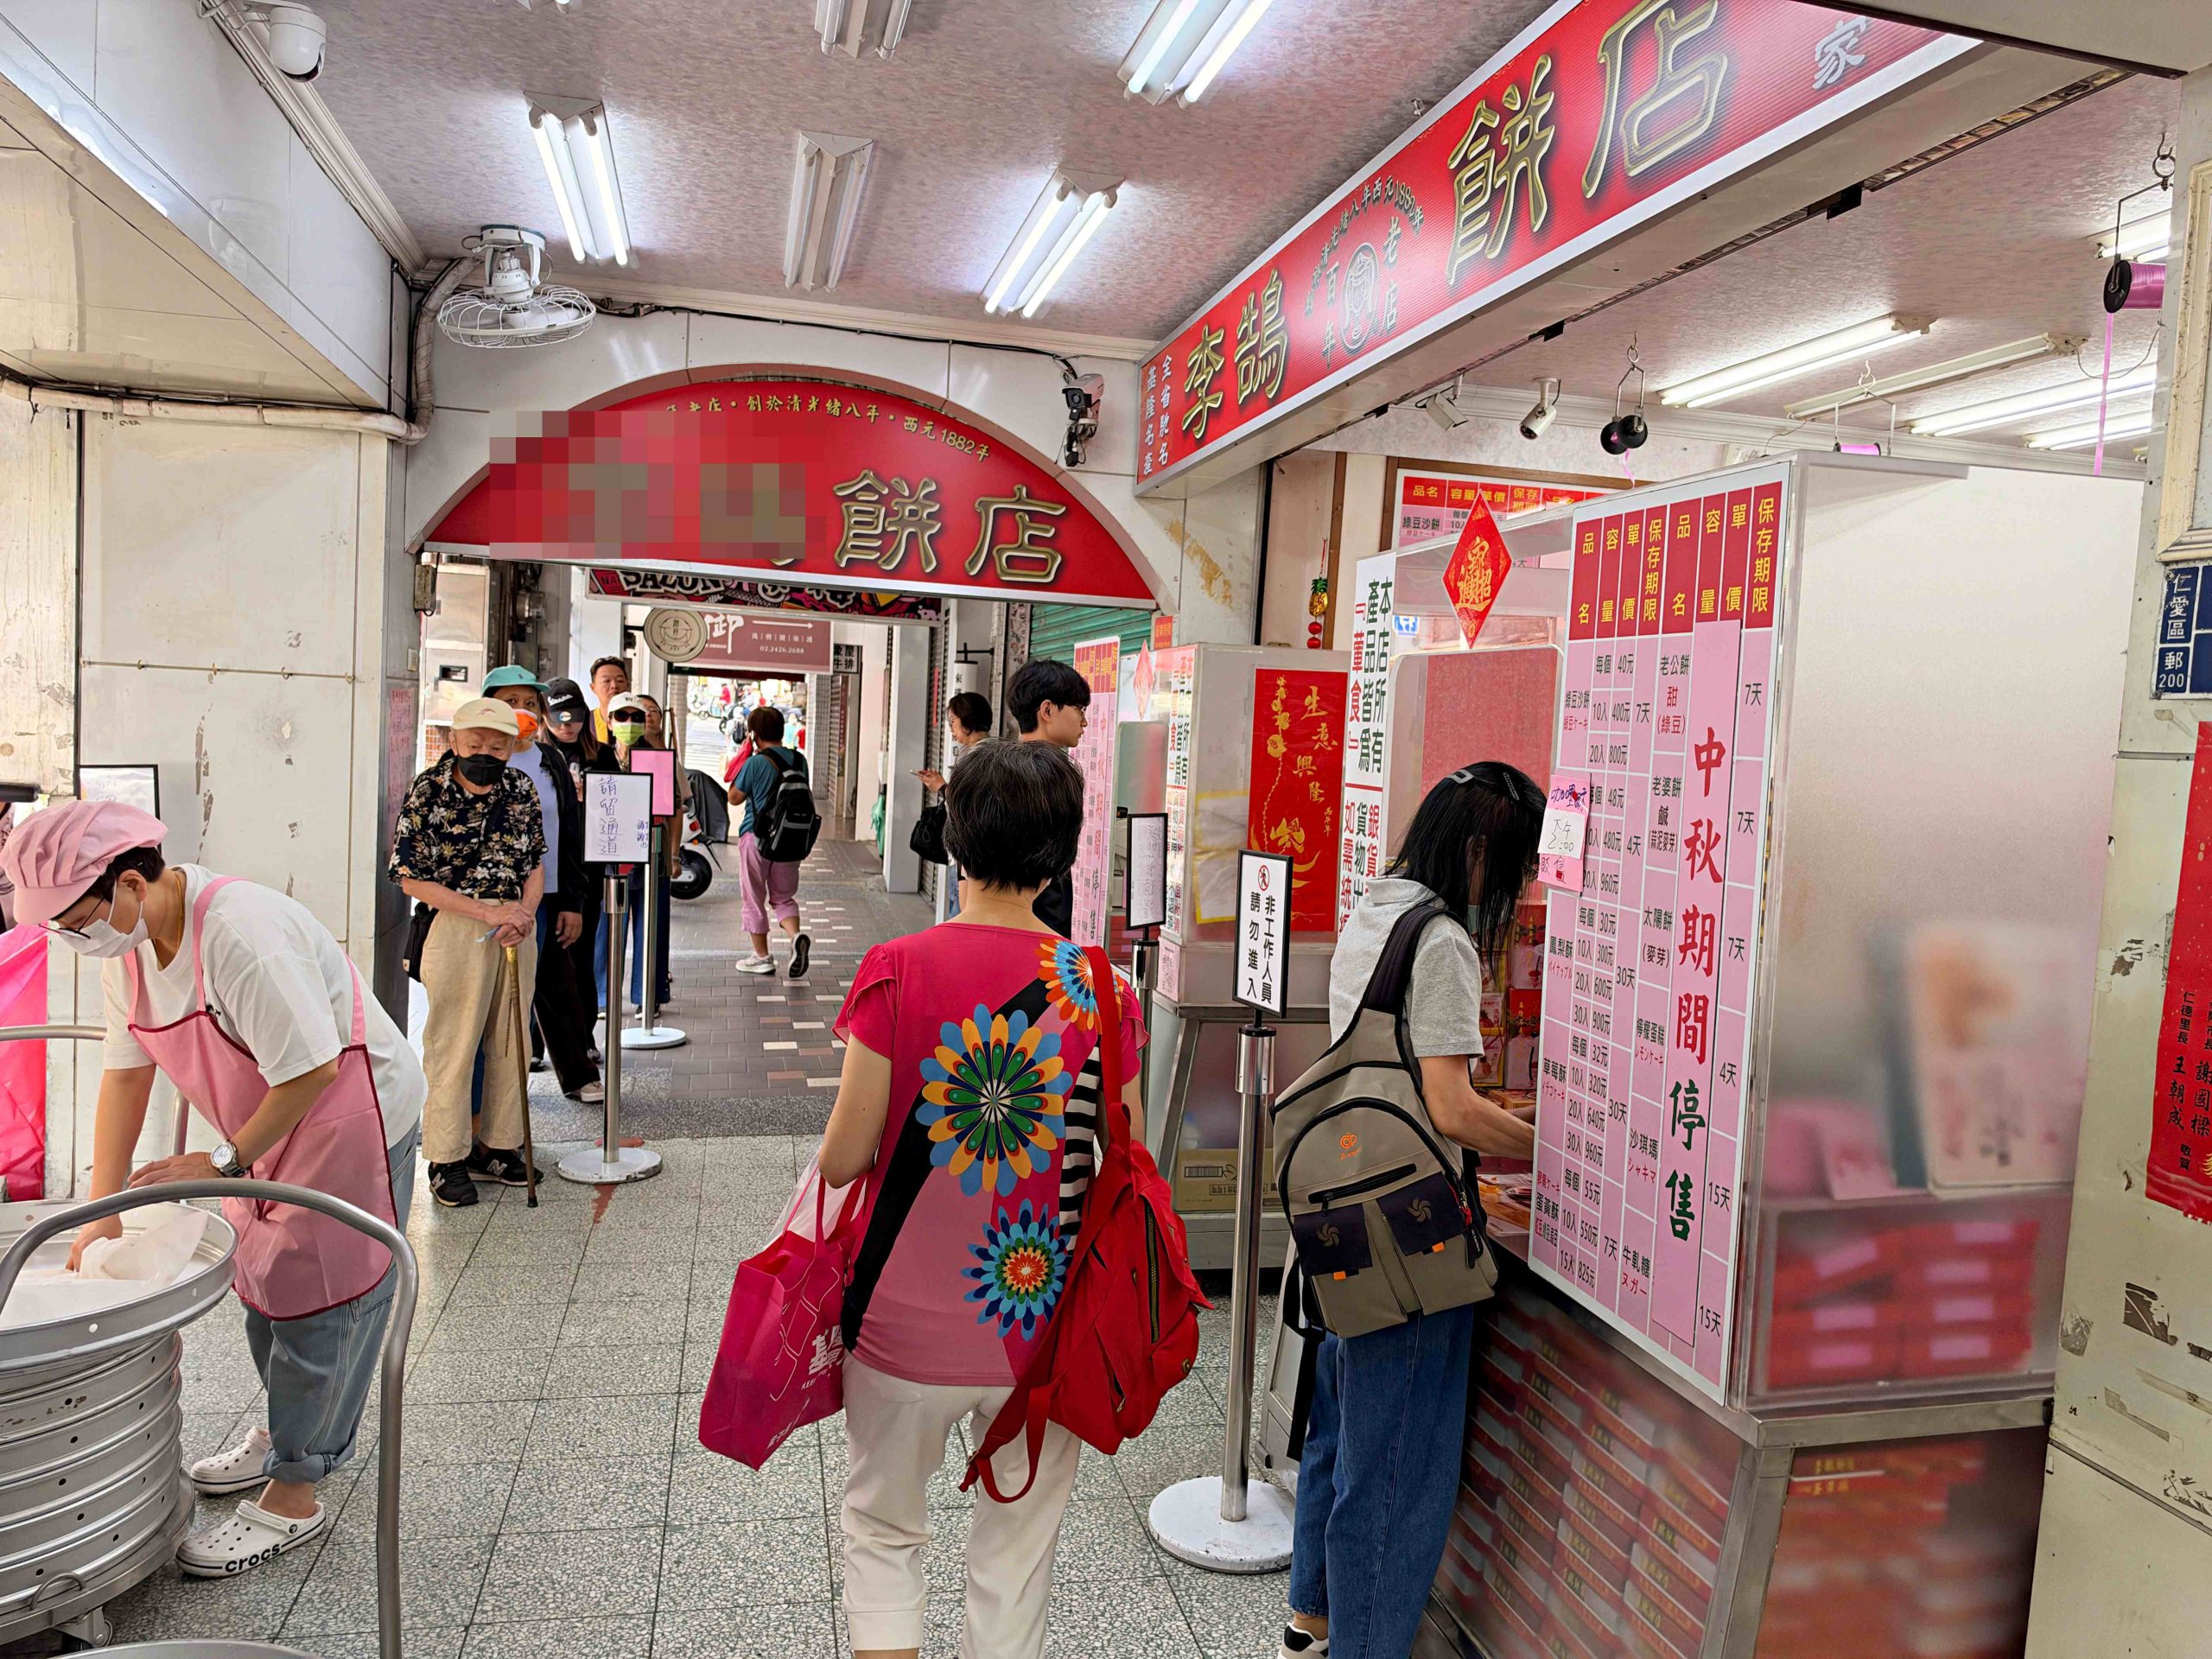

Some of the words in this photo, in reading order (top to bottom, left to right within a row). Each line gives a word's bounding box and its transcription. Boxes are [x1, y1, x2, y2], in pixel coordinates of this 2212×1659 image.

[1813, 16, 1867, 90] 家
[1182, 268, 1291, 440] 李鵠
[1446, 0, 1727, 286] 餅店
[1382, 216, 1402, 334] 老店
[1322, 261, 1340, 369] 百年
[1143, 365, 1157, 475] 基隆名產
[1158, 355, 1173, 465] 全省馳名
[1413, 485, 1439, 498] 品名
[1450, 487, 1476, 500] 容量
[1578, 532, 1595, 625] 品名
[1601, 528, 1619, 623] 容量
[1622, 524, 1640, 620] 單價
[1643, 518, 1662, 621] 保存期限
[1672, 514, 1690, 616] 品名
[1700, 509, 1721, 614] 容量
[1726, 503, 1747, 613] 單價
[1751, 497, 1775, 613] 保存期限
[2167, 574, 2192, 640] 仁愛區
[1372, 576, 1393, 774] 本店所有
[1596, 654, 1611, 674] 每個
[1618, 653, 1634, 674] 40元
[1660, 654, 1690, 677] 老公餅
[2164, 652, 2184, 671] 郵
[1745, 683, 1763, 707] 7天
[2158, 673, 2184, 688] 200
[1592, 702, 1608, 721] 10入
[1612, 702, 1631, 722] 400元
[1636, 702, 1651, 723] 7天
[1667, 686, 1679, 708] 甜
[1293, 686, 1338, 803] 生意興隆
[1589, 745, 1605, 765] 20入
[1609, 745, 1628, 766] 800元
[1608, 788, 1624, 809] 48元
[1652, 776, 1681, 798] 老婆餅
[1738, 811, 1755, 835] 7天
[1365, 804, 1380, 894] 銀貨
[1587, 828, 1599, 849] 0入
[1603, 831, 1622, 852] 480元
[1627, 836, 1642, 856] 4天
[1600, 873, 1619, 895] 960元
[1580, 907, 1595, 927] 每個
[1599, 912, 1617, 935] 30元
[1643, 906, 1673, 932] 太陽餅
[1247, 892, 1261, 1000] 請勿進入
[1261, 895, 1275, 1005] 非工作人員
[1643, 943, 1669, 969] (麥芽)
[1727, 937, 1745, 962] 7天
[1578, 938, 1592, 961] 10入
[1597, 944, 1614, 967] 300元
[1617, 966, 1636, 989] 30天
[1575, 972, 1591, 995] 20入
[1594, 976, 1612, 1001] 600元
[1665, 727, 1726, 1242] 中秋期間停售
[1573, 1005, 1589, 1028] 30入
[1592, 1011, 1611, 1035] 900元
[2177, 990, 2195, 1045] 仁德里長
[1572, 1035, 1587, 1058] 每個
[1592, 1044, 1608, 1067] 32元
[1719, 1062, 1738, 1088] 4天
[1572, 1065, 1585, 1090] 10入
[1588, 1073, 1607, 1099] 320元
[1608, 1099, 1627, 1126] 30天
[1568, 1098, 1583, 1123] 20入
[1587, 1107, 1605, 1133] 640元
[1567, 1131, 1582, 1156] 30入
[1585, 1141, 1603, 1167] 960元
[1629, 1128, 1659, 1160] 沙琪瑪
[1565, 1168, 1580, 1192] 每個
[1584, 1180, 1601, 1205] 55元
[1708, 1182, 1731, 1212] 15天
[1562, 1209, 1577, 1234] 10入
[1580, 1220, 1599, 1248] 550元
[1604, 1236, 1618, 1262] 7天
[1560, 1249, 1575, 1276] 15入
[1578, 1261, 1595, 1288] 825元
[1622, 1245, 1651, 1279] 牛軋糖
[1621, 1272, 1647, 1296] ヌガー
[1700, 1305, 1721, 1338] 15天
[225, 1543, 281, 1573] crocs
